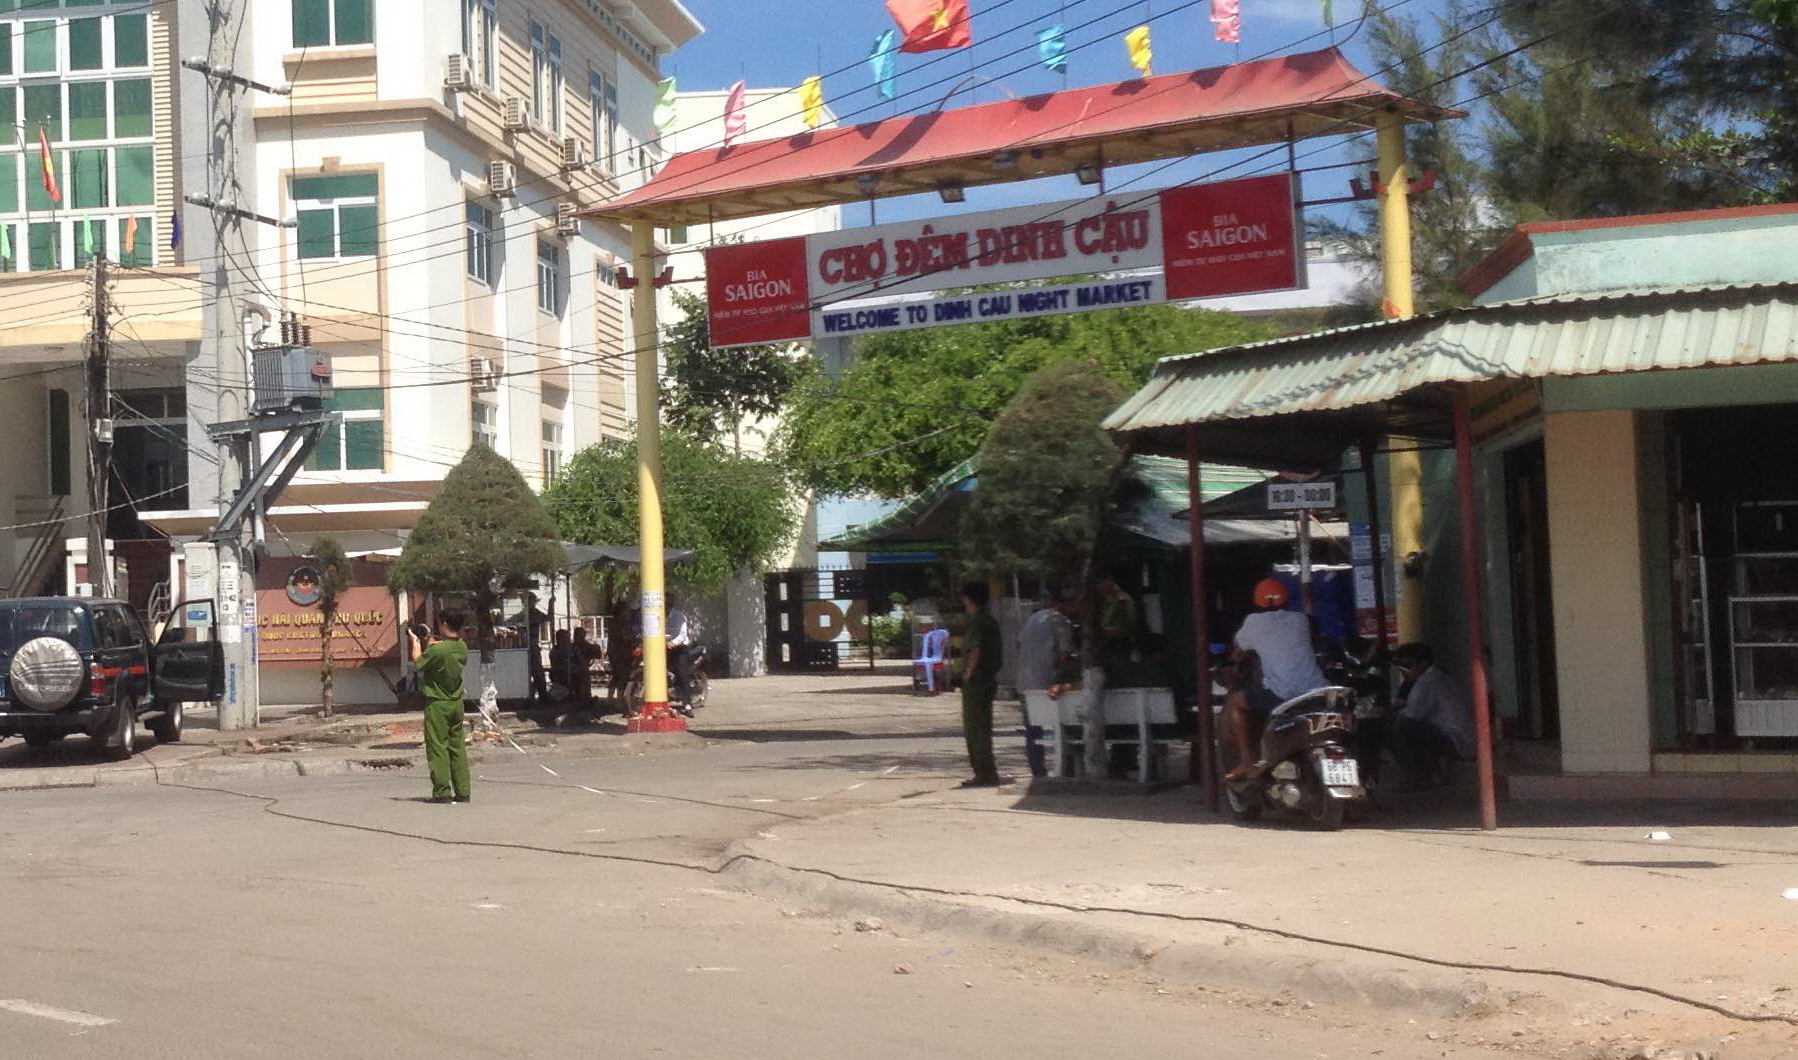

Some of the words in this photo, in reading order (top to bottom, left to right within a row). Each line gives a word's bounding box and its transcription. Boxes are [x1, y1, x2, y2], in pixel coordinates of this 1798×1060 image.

[1213, 213, 1239, 227] BIA
[819, 238, 887, 288] CHỢ
[894, 224, 969, 276] ĐÊM
[1074, 200, 1150, 264] CẬU
[746, 269, 769, 282] BIA
[823, 307, 900, 332] WELCOME
[906, 304, 928, 325] TO
[934, 299, 972, 322] DINH
[978, 294, 1012, 317] CAU
[1017, 289, 1070, 312] NIGHT
[1076, 280, 1153, 307] MARKET
